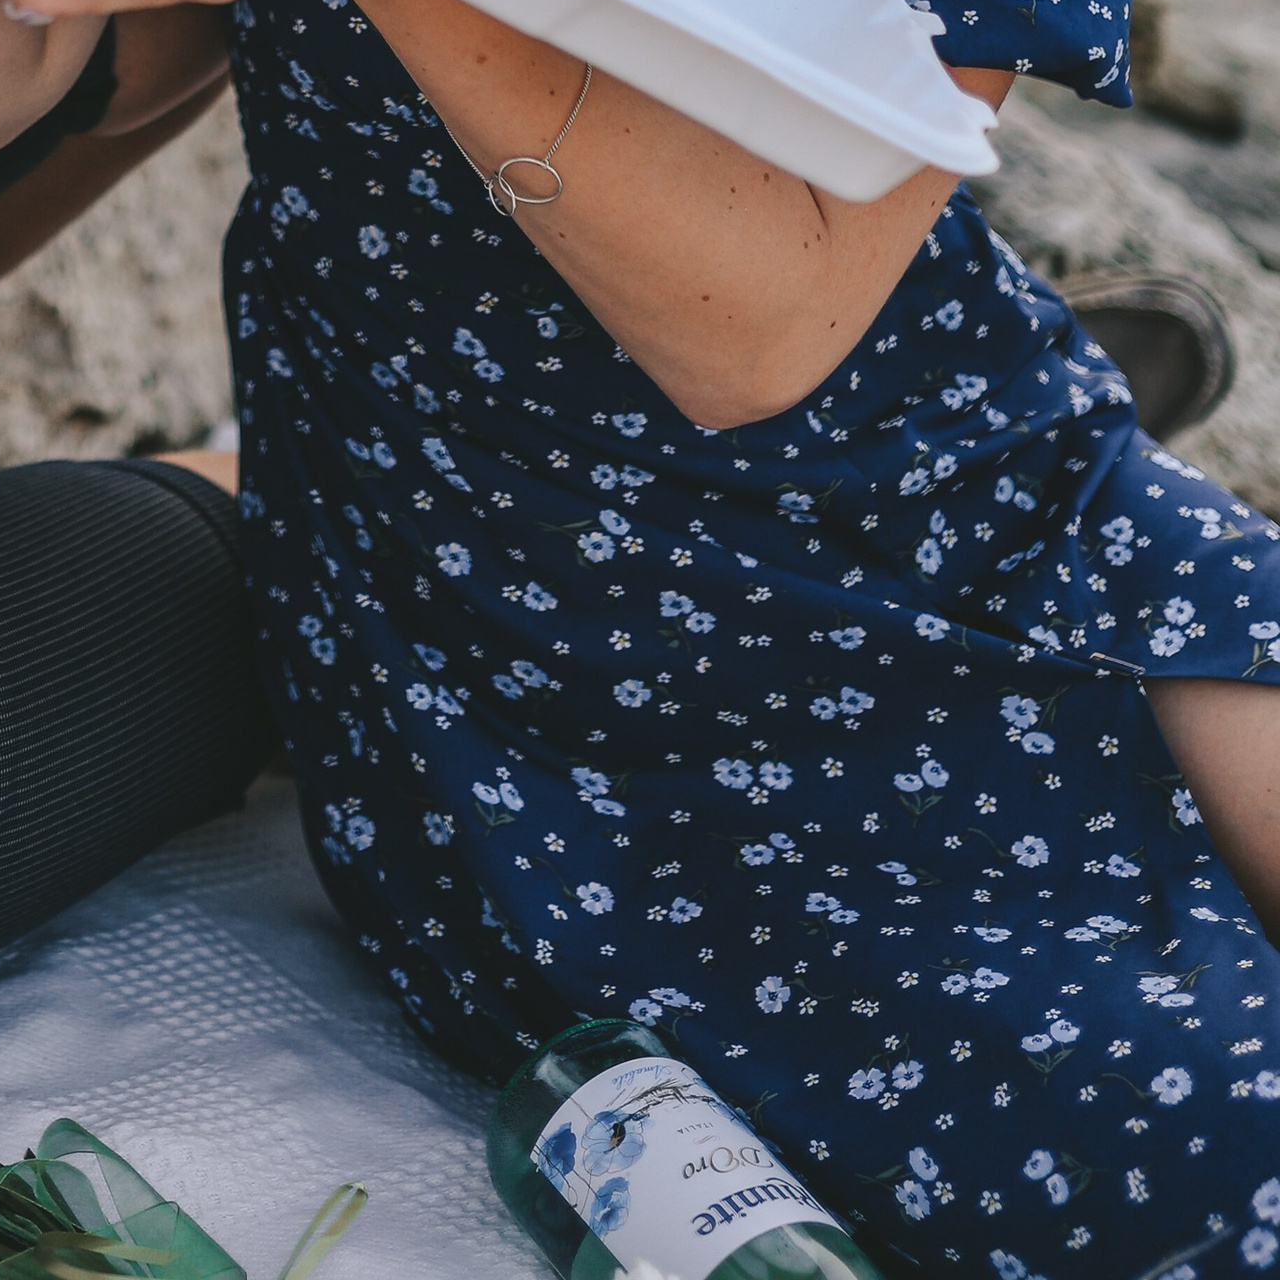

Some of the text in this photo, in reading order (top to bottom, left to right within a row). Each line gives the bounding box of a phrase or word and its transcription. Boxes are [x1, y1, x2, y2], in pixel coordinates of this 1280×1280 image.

[611, 1064, 672, 1090] Amabile
[677, 1122, 714, 1134] ITALIA
[682, 1146, 774, 1179] D'Oro
[692, 1177, 826, 1236] Riunite
